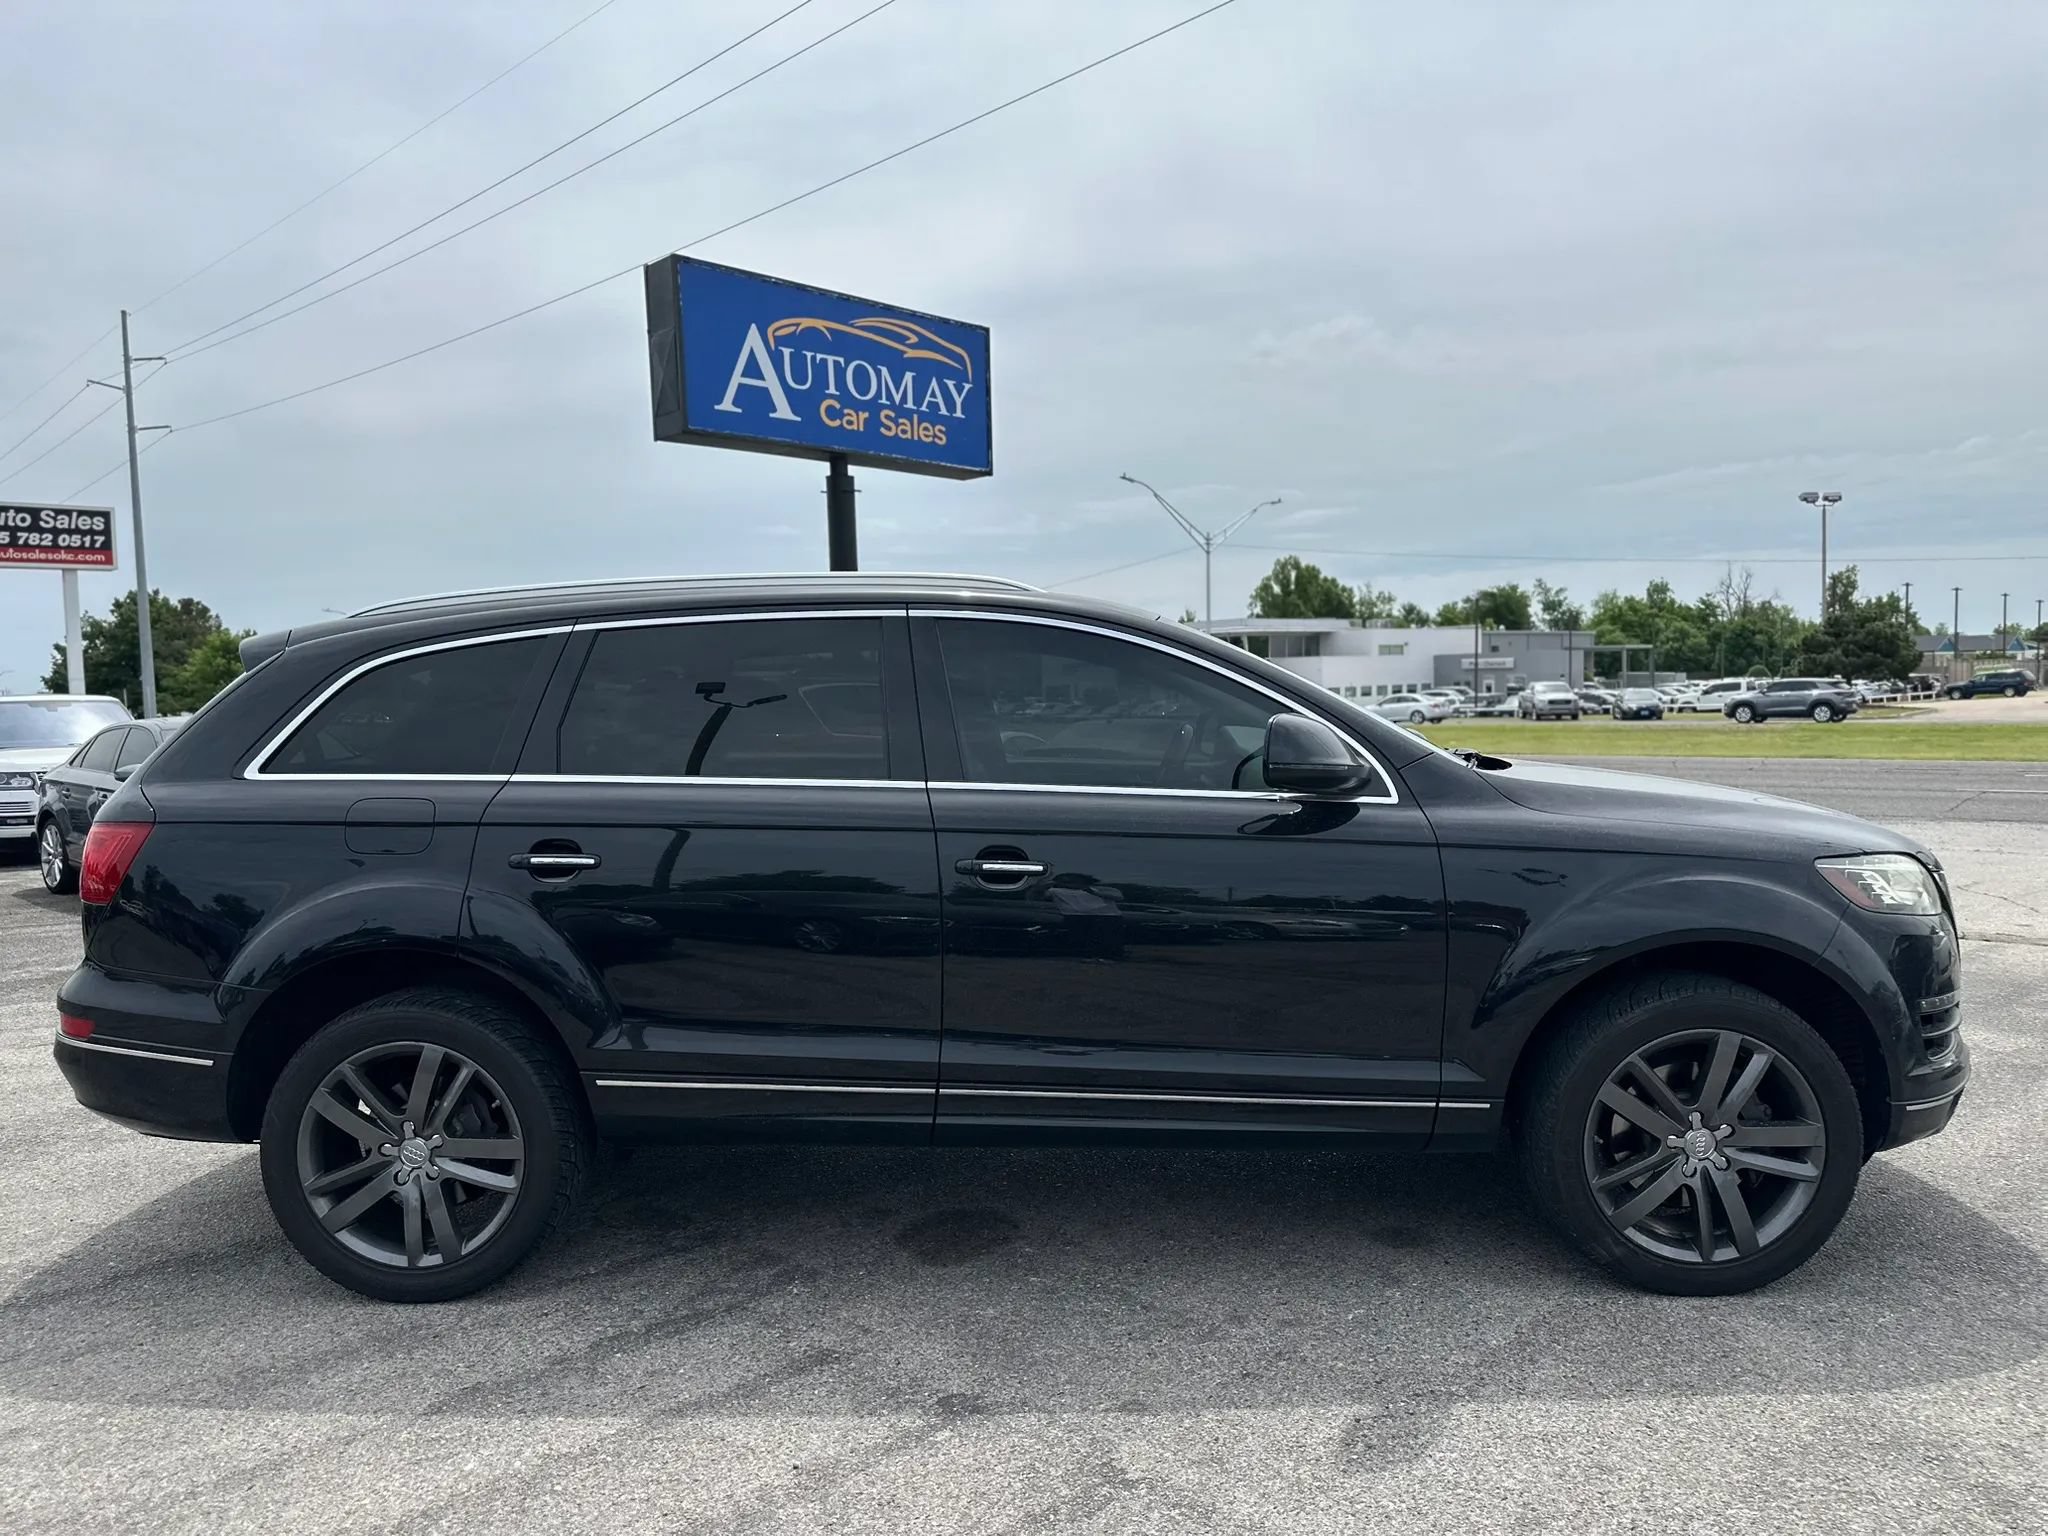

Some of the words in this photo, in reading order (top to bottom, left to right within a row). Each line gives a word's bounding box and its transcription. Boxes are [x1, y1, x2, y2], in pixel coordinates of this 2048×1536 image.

[713, 322, 973, 421] AUTOMAY
[820, 399, 868, 432] Car
[879, 409, 947, 444] Sales
[39, 510, 105, 530] Sales
[17, 532, 53, 546] 782
[58, 534, 105, 548] 0517
